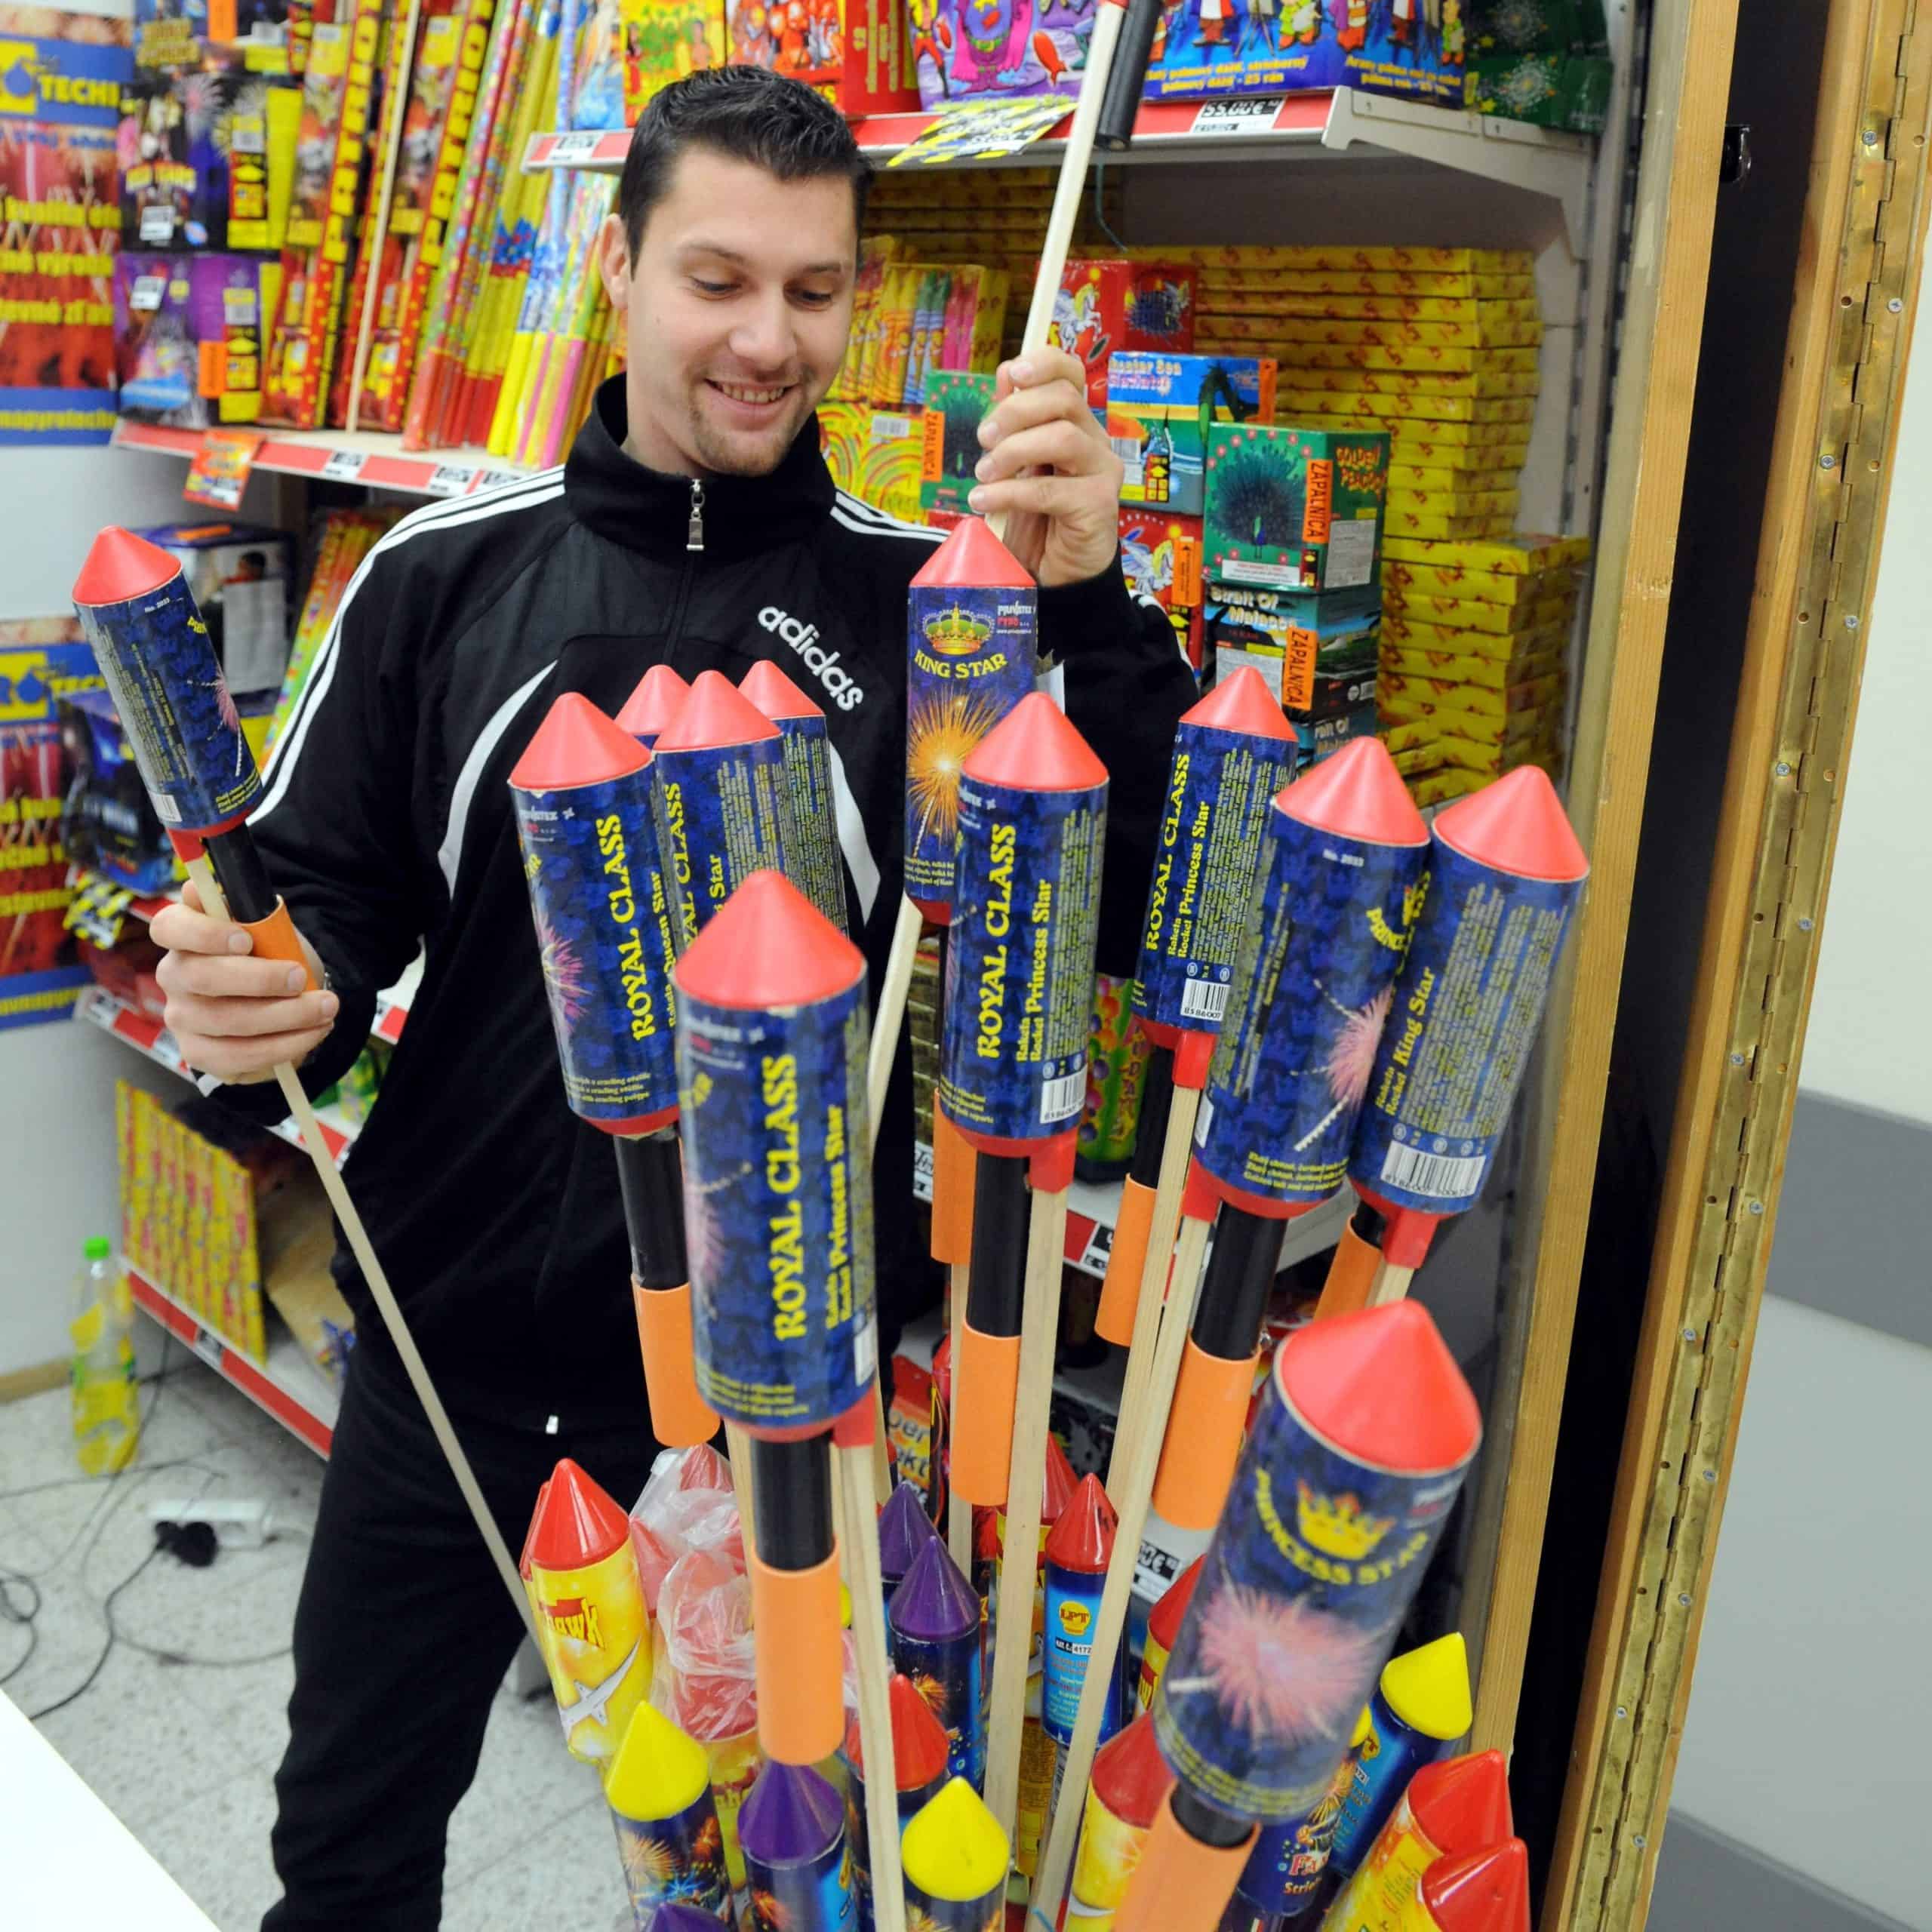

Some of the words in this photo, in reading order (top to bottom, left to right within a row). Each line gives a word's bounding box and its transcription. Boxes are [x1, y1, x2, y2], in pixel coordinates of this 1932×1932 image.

[1306, 463, 1329, 537] ZAPALNICA
[757, 606, 864, 712] adidas
[915, 648, 952, 679] KING
[954, 652, 1009, 680] STAR
[596, 814, 635, 924] CLASS
[664, 782, 691, 886] CLASS
[709, 854, 727, 900] Star
[985, 823, 1017, 937] CLASS
[1145, 854, 1173, 952] ROYAL
[1163, 753, 1191, 848] CLASS
[1178, 841, 1204, 916] Princess
[1191, 800, 1211, 838] Star
[1032, 878, 1053, 924] Star
[618, 928, 657, 1041] ROYAL
[977, 944, 1008, 1060] ROYAL
[1025, 928, 1049, 1014] Princess
[1408, 966, 1436, 1019] Star
[1392, 1018, 1425, 1069] King
[761, 1054, 802, 1195] CLASS
[768, 1200, 808, 1342] ROYAL
[1254, 1466, 1353, 1586] PRINCESS
[1060, 1607, 1090, 1625] LPT
